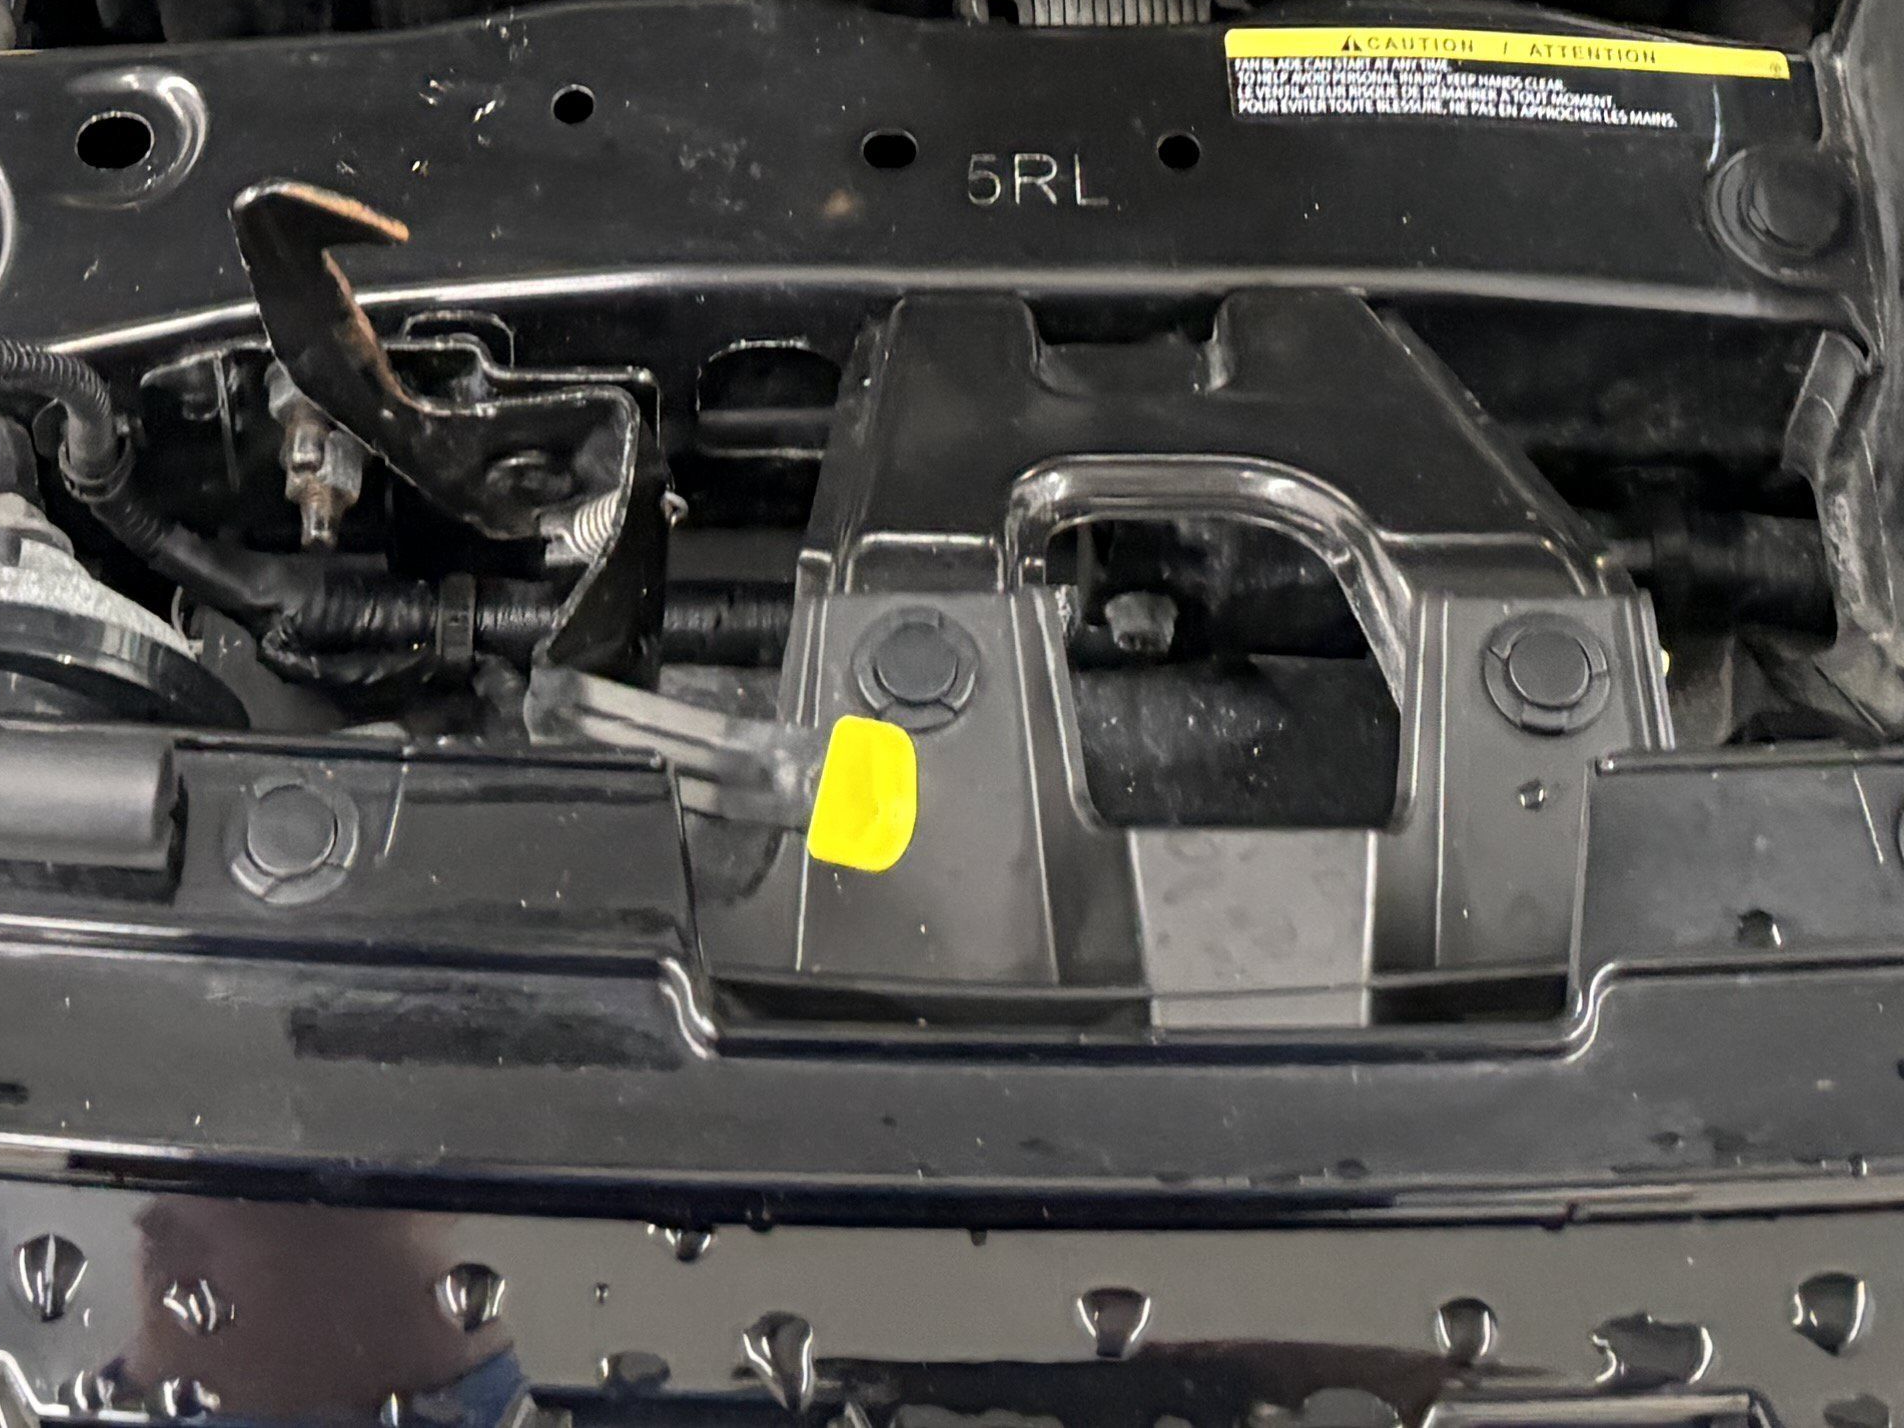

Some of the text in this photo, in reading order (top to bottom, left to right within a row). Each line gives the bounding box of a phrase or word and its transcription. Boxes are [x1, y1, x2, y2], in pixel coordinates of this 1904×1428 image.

[1366, 35, 1475, 54] CAUTION
[1529, 42, 1657, 64] ATTENTION
[1235, 57, 1260, 71] FAN
[1305, 58, 1332, 71] CAN
[1334, 58, 1371, 71] START
[1374, 58, 1388, 71] AT
[1392, 58, 1417, 71] ANY
[1237, 71, 1255, 84] TO
[1256, 71, 1288, 85] HELP
[1291, 72, 1331, 85] AVOID
[1332, 72, 1398, 86] PERSONAL
[1446, 72, 1477, 88] KEEP
[1478, 74, 1523, 90] HANDS
[1238, 85, 1251, 99] LE
[1255, 85, 1347, 99] VENTILATEUR
[1401, 86, 1421, 100] DE
[1513, 90, 1548, 105] TOUT
[1238, 99, 1279, 114] POUR
[1328, 99, 1374, 114] TOUTE
[1449, 101, 1468, 116] NE
[1471, 102, 1496, 118] PAS
[1498, 103, 1517, 119] EN
[1519, 105, 1602, 123] APPROCHER
[1603, 109, 1628, 125] LES
[965, 150, 1111, 209] 5RL
